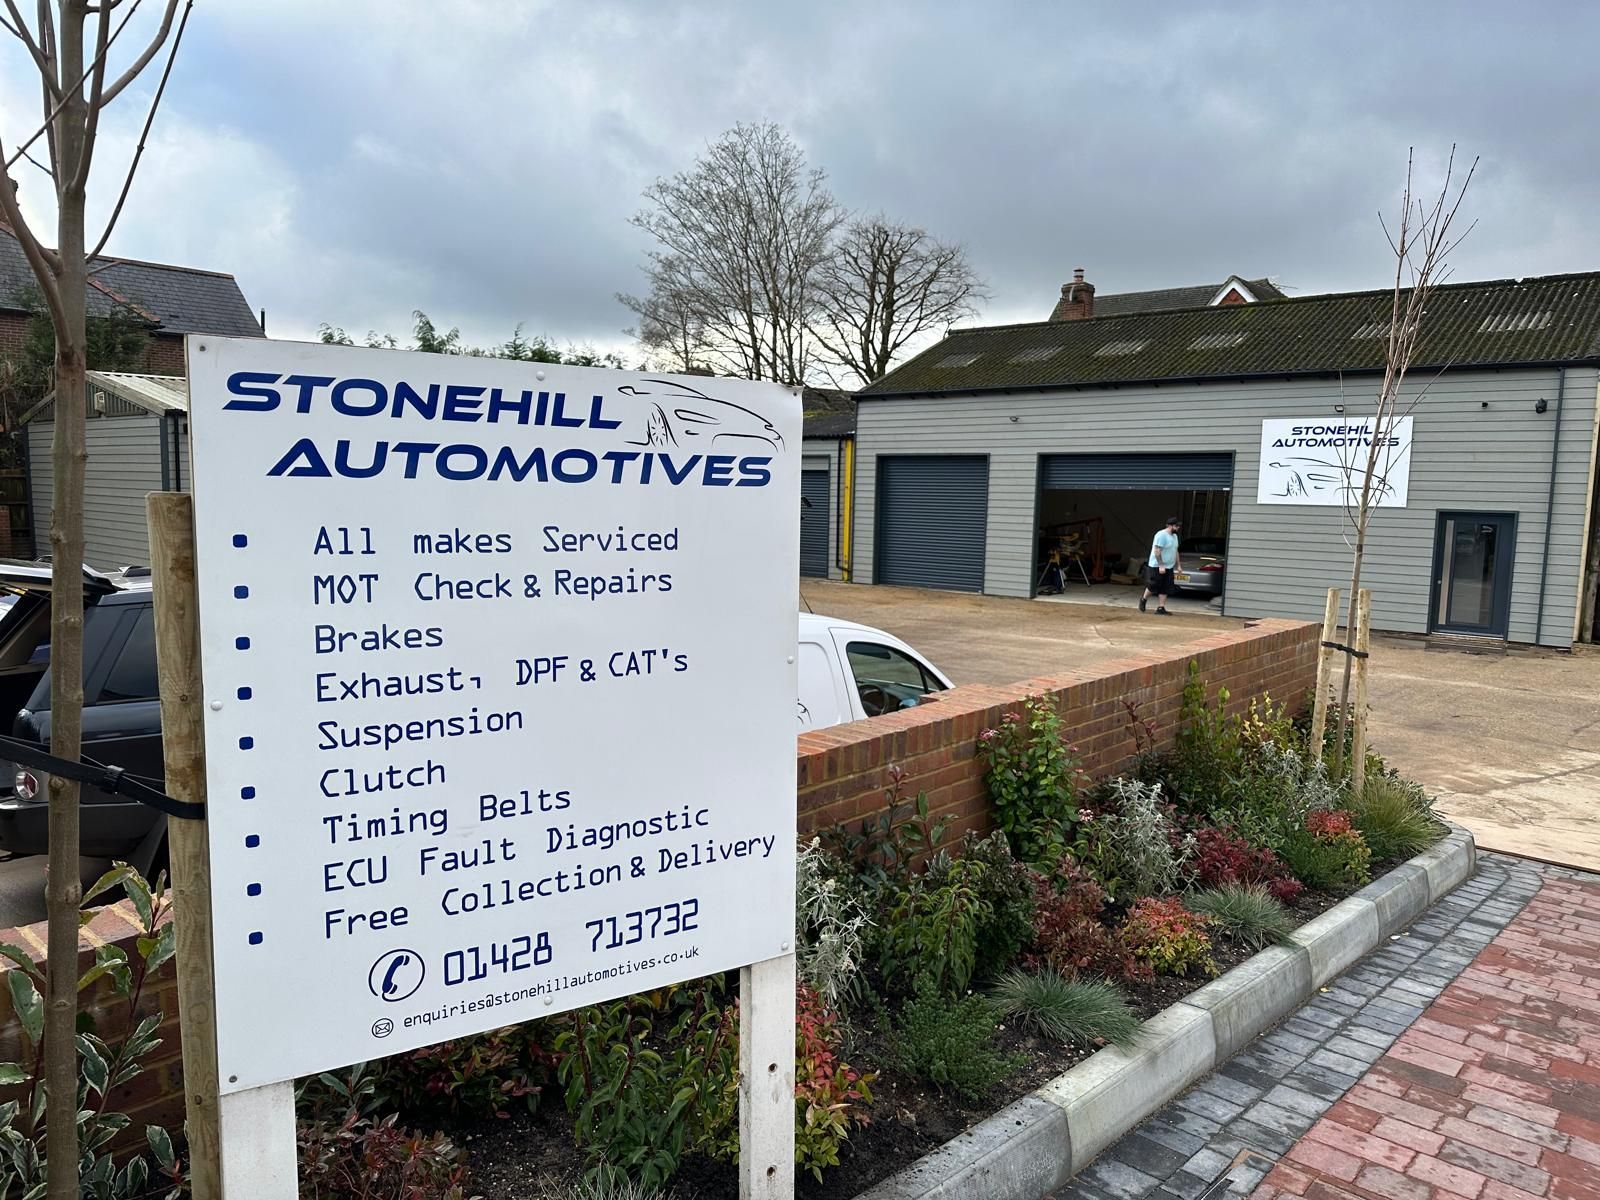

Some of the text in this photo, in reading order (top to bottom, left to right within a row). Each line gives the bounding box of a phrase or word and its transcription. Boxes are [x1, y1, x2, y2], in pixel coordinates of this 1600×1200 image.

[222, 371, 623, 429] STONEHILL
[266, 438, 773, 487] AUTOMOTIVES
[314, 526, 677, 554] All makes Serviced
[314, 568, 671, 604] MOT Check & Repairs
[315, 624, 442, 653] Brakes
[516, 656, 568, 685] DPF
[580, 660, 595, 681] &
[609, 649, 687, 677] CAT's
[318, 708, 522, 750] Suspension
[320, 760, 446, 798] Clutch
[323, 790, 570, 843] Timing Belts
[325, 806, 709, 892] ECU Fault Diagnostic
[326, 835, 774, 938] Free Collection & Delivery
[444, 899, 699, 986] 01428 713732
[403, 945, 699, 1028] enquiries@stonehillautomotives.co.uk
